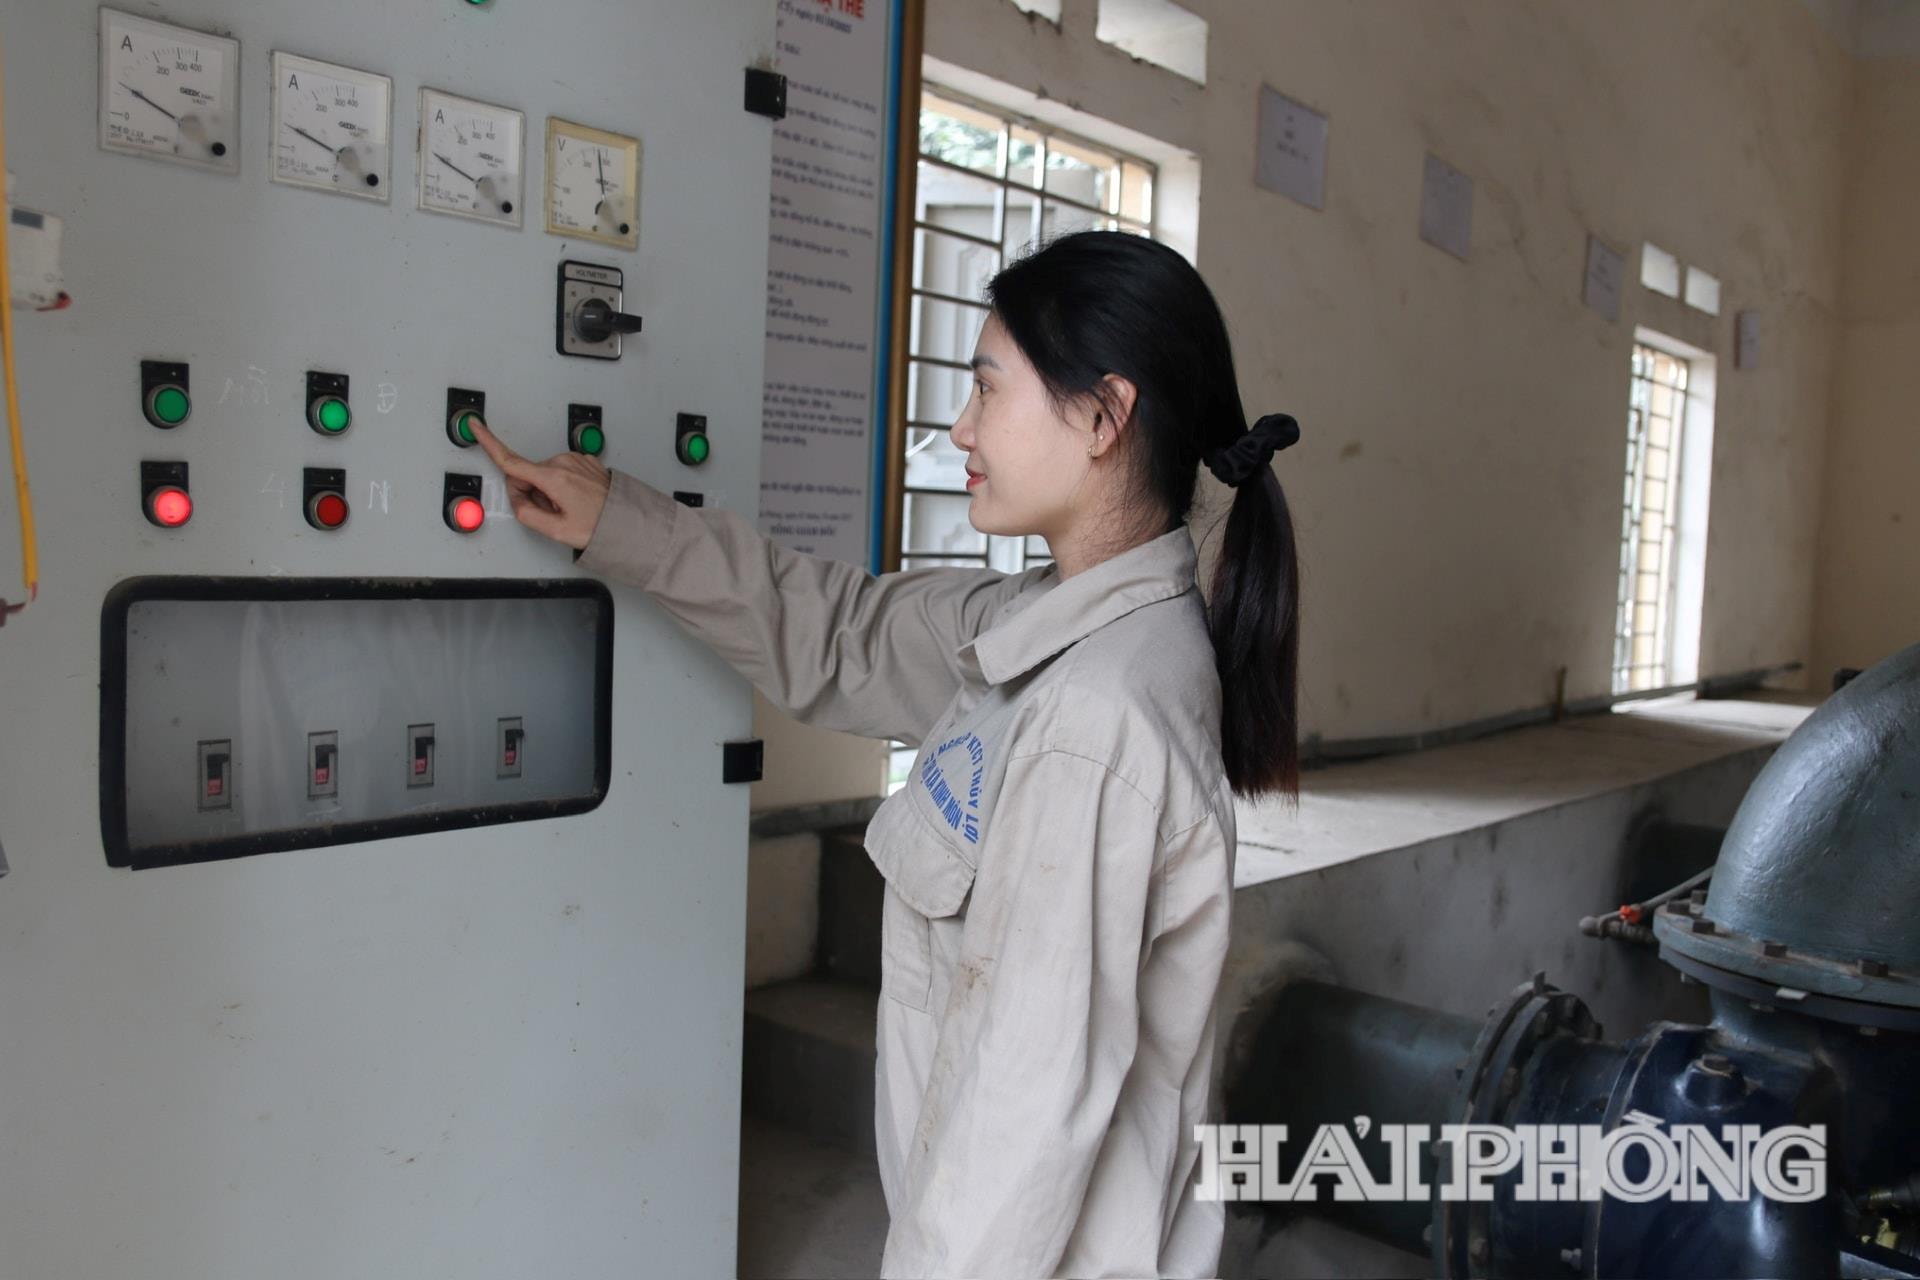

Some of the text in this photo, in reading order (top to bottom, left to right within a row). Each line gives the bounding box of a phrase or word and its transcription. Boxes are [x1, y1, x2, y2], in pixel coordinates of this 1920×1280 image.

[121, 35, 132, 52] A
[190, 62, 203, 73] 400
[288, 73, 299, 90] A
[435, 109, 445, 124] A
[558, 138, 566, 151] V
